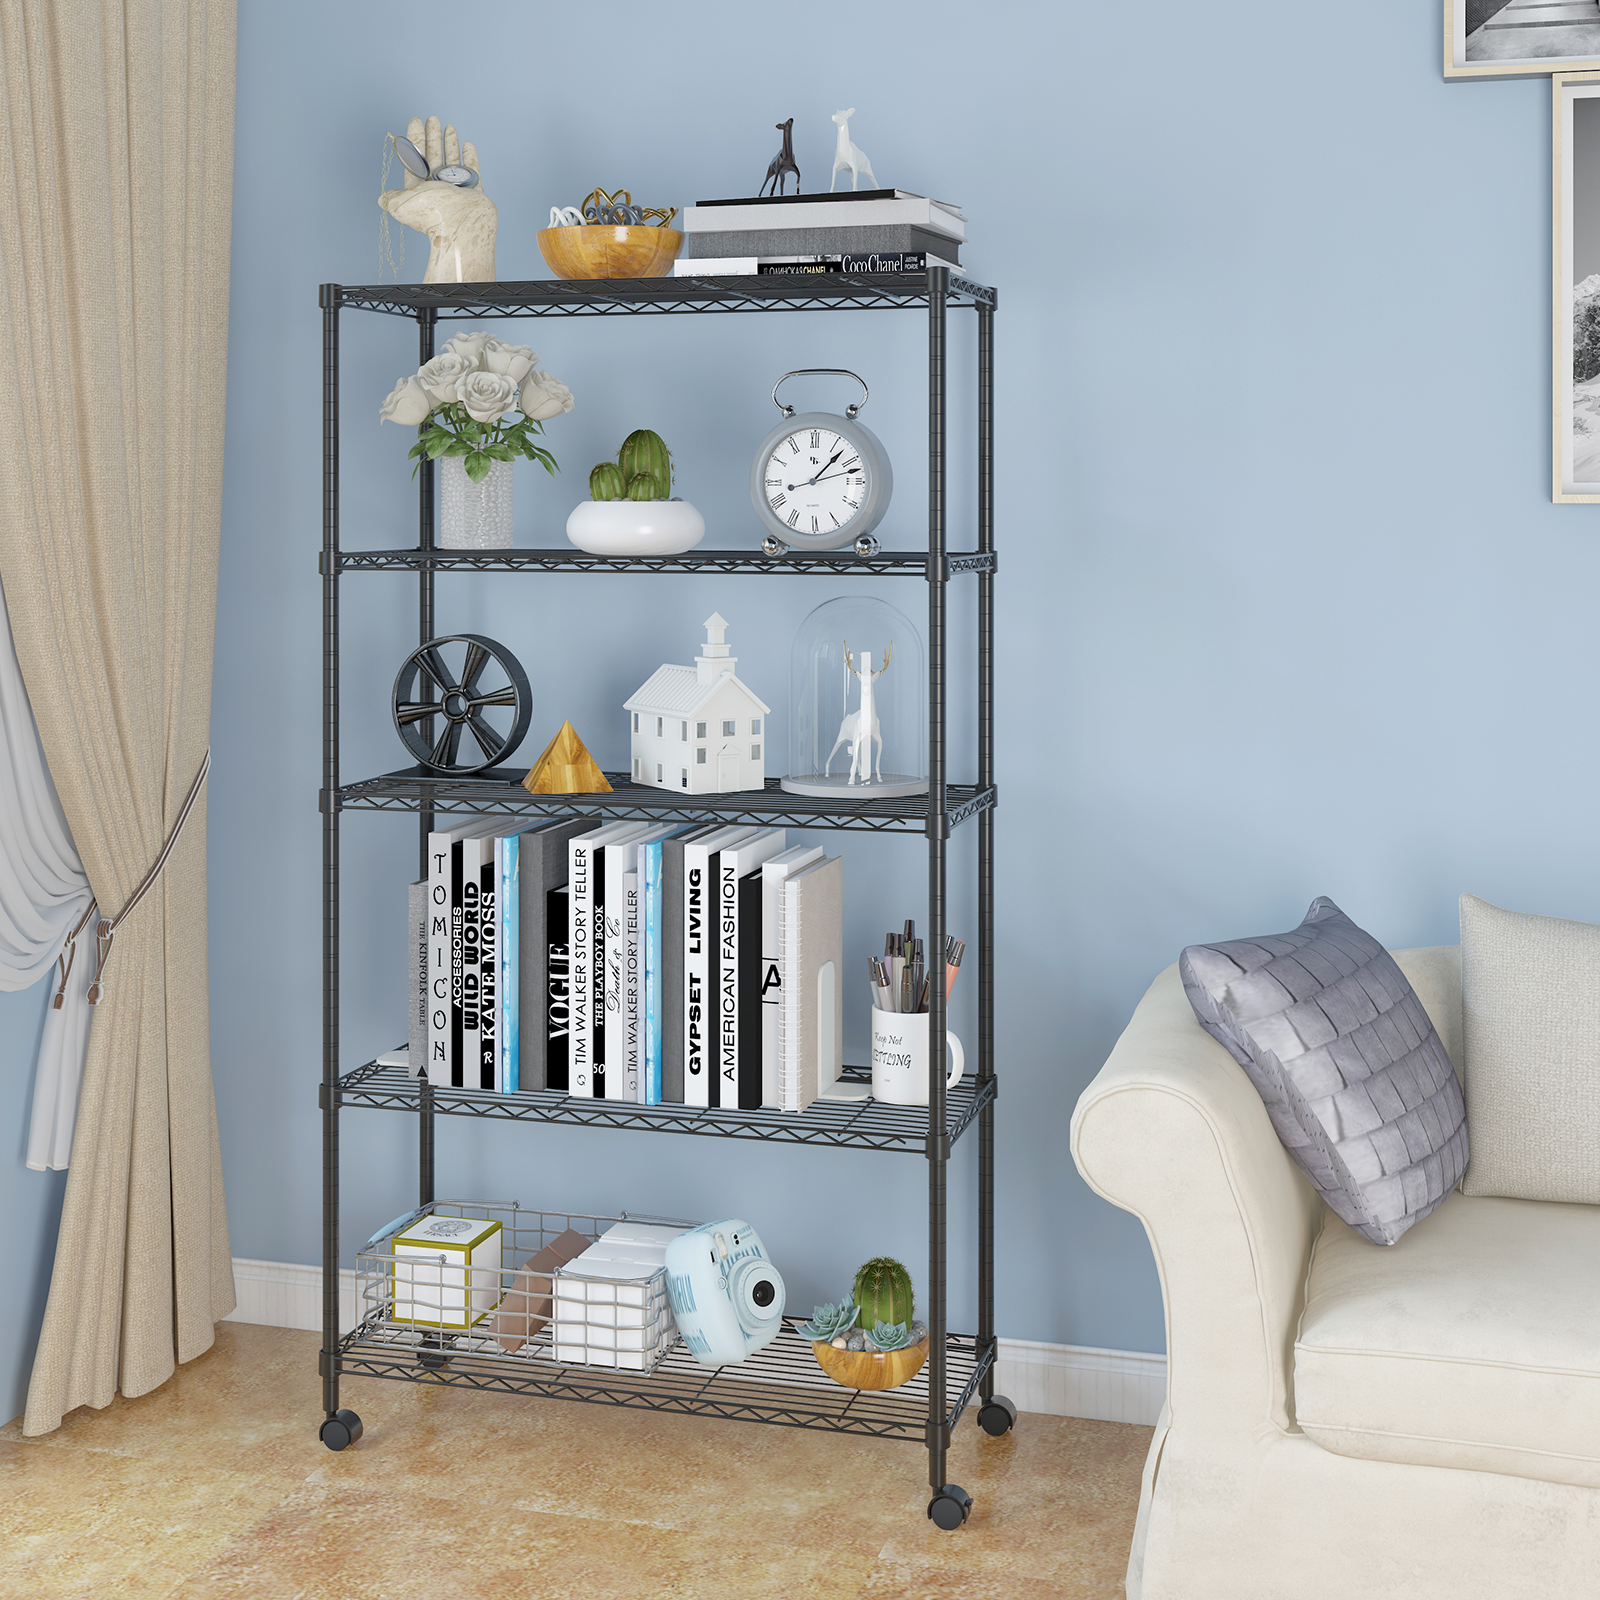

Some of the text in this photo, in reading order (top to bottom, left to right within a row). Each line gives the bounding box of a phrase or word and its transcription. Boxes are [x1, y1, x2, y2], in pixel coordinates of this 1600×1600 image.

[810, 432, 819, 448] XII
[419, 942, 428, 996] KINFOLK
[453, 906, 462, 1008] ACCESSORIES
[464, 881, 479, 1030] WILD WORLD
[481, 892, 495, 1042] KATE MOSS
[575, 848, 587, 1065] TIM WALKER STORY TELLER
[595, 905, 604, 1027] THE PLAYBOY BOOK
[605, 916, 620, 939] Co
[689, 868, 701, 1075] GYPSET LIVING
[723, 867, 735, 1082] AMERICAN FASHION
[549, 943, 569, 1040] VOGUE
[606, 958, 621, 1014] Death
[627, 890, 638, 1073] TIM WALKER STORY TELLER
[592, 1062, 605, 1074] 50
[873, 1048, 911, 1069] ETTLING
[888, 1035, 903, 1045] Not
